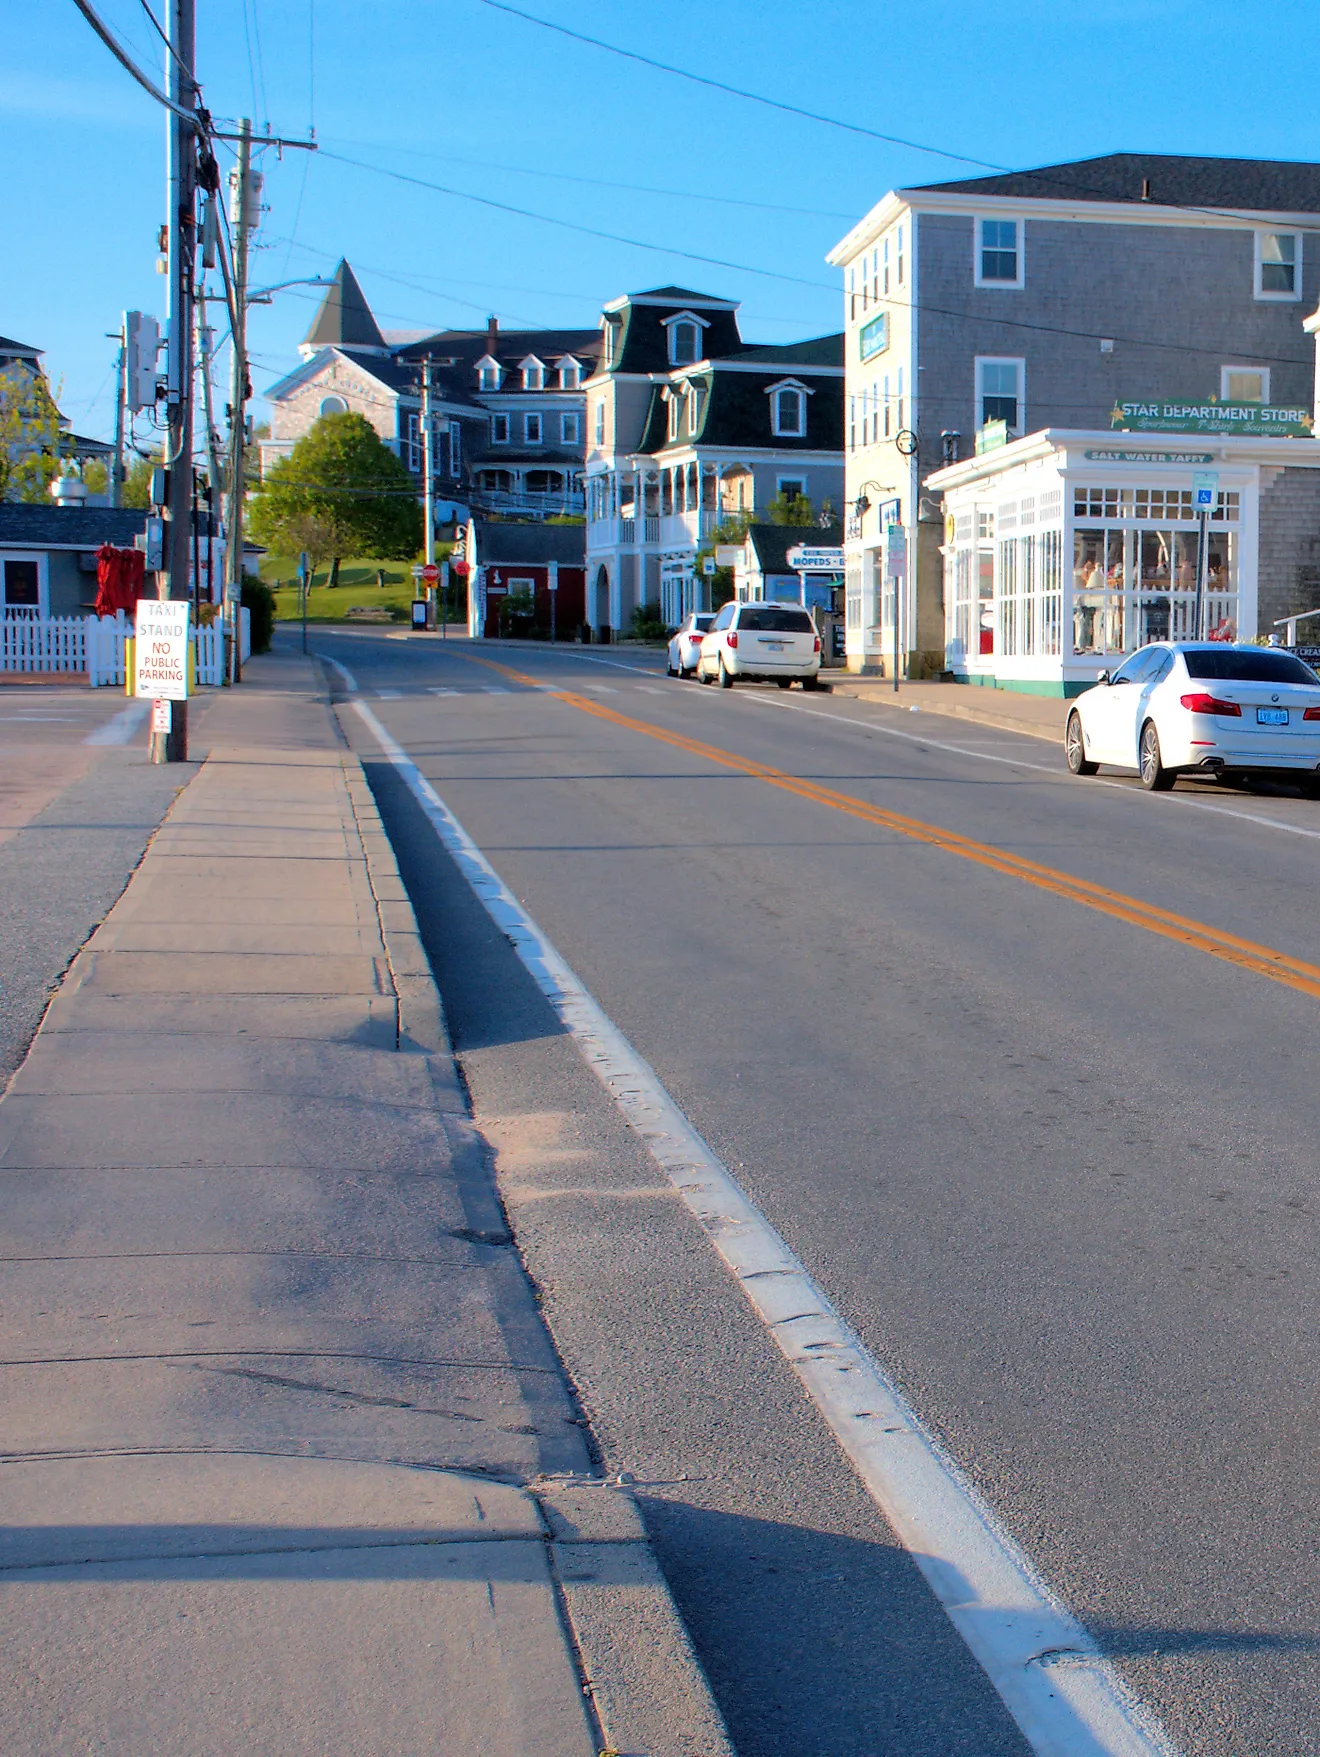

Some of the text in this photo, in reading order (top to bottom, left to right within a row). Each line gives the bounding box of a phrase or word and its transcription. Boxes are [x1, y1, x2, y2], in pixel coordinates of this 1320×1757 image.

[1122, 403, 1307, 423] STAR DEPARTMENT STORE
[1243, 420, 1288, 432] Souvenirs
[1091, 450, 1206, 463] SALT WATER TAFFY
[793, 557, 831, 566] MOPEDS
[148, 604, 177, 617] TAXI
[140, 624, 183, 637] STAND
[152, 642, 171, 655] NO
[144, 657, 181, 668] PUBLIC
[139, 669, 184, 681] PARKING
